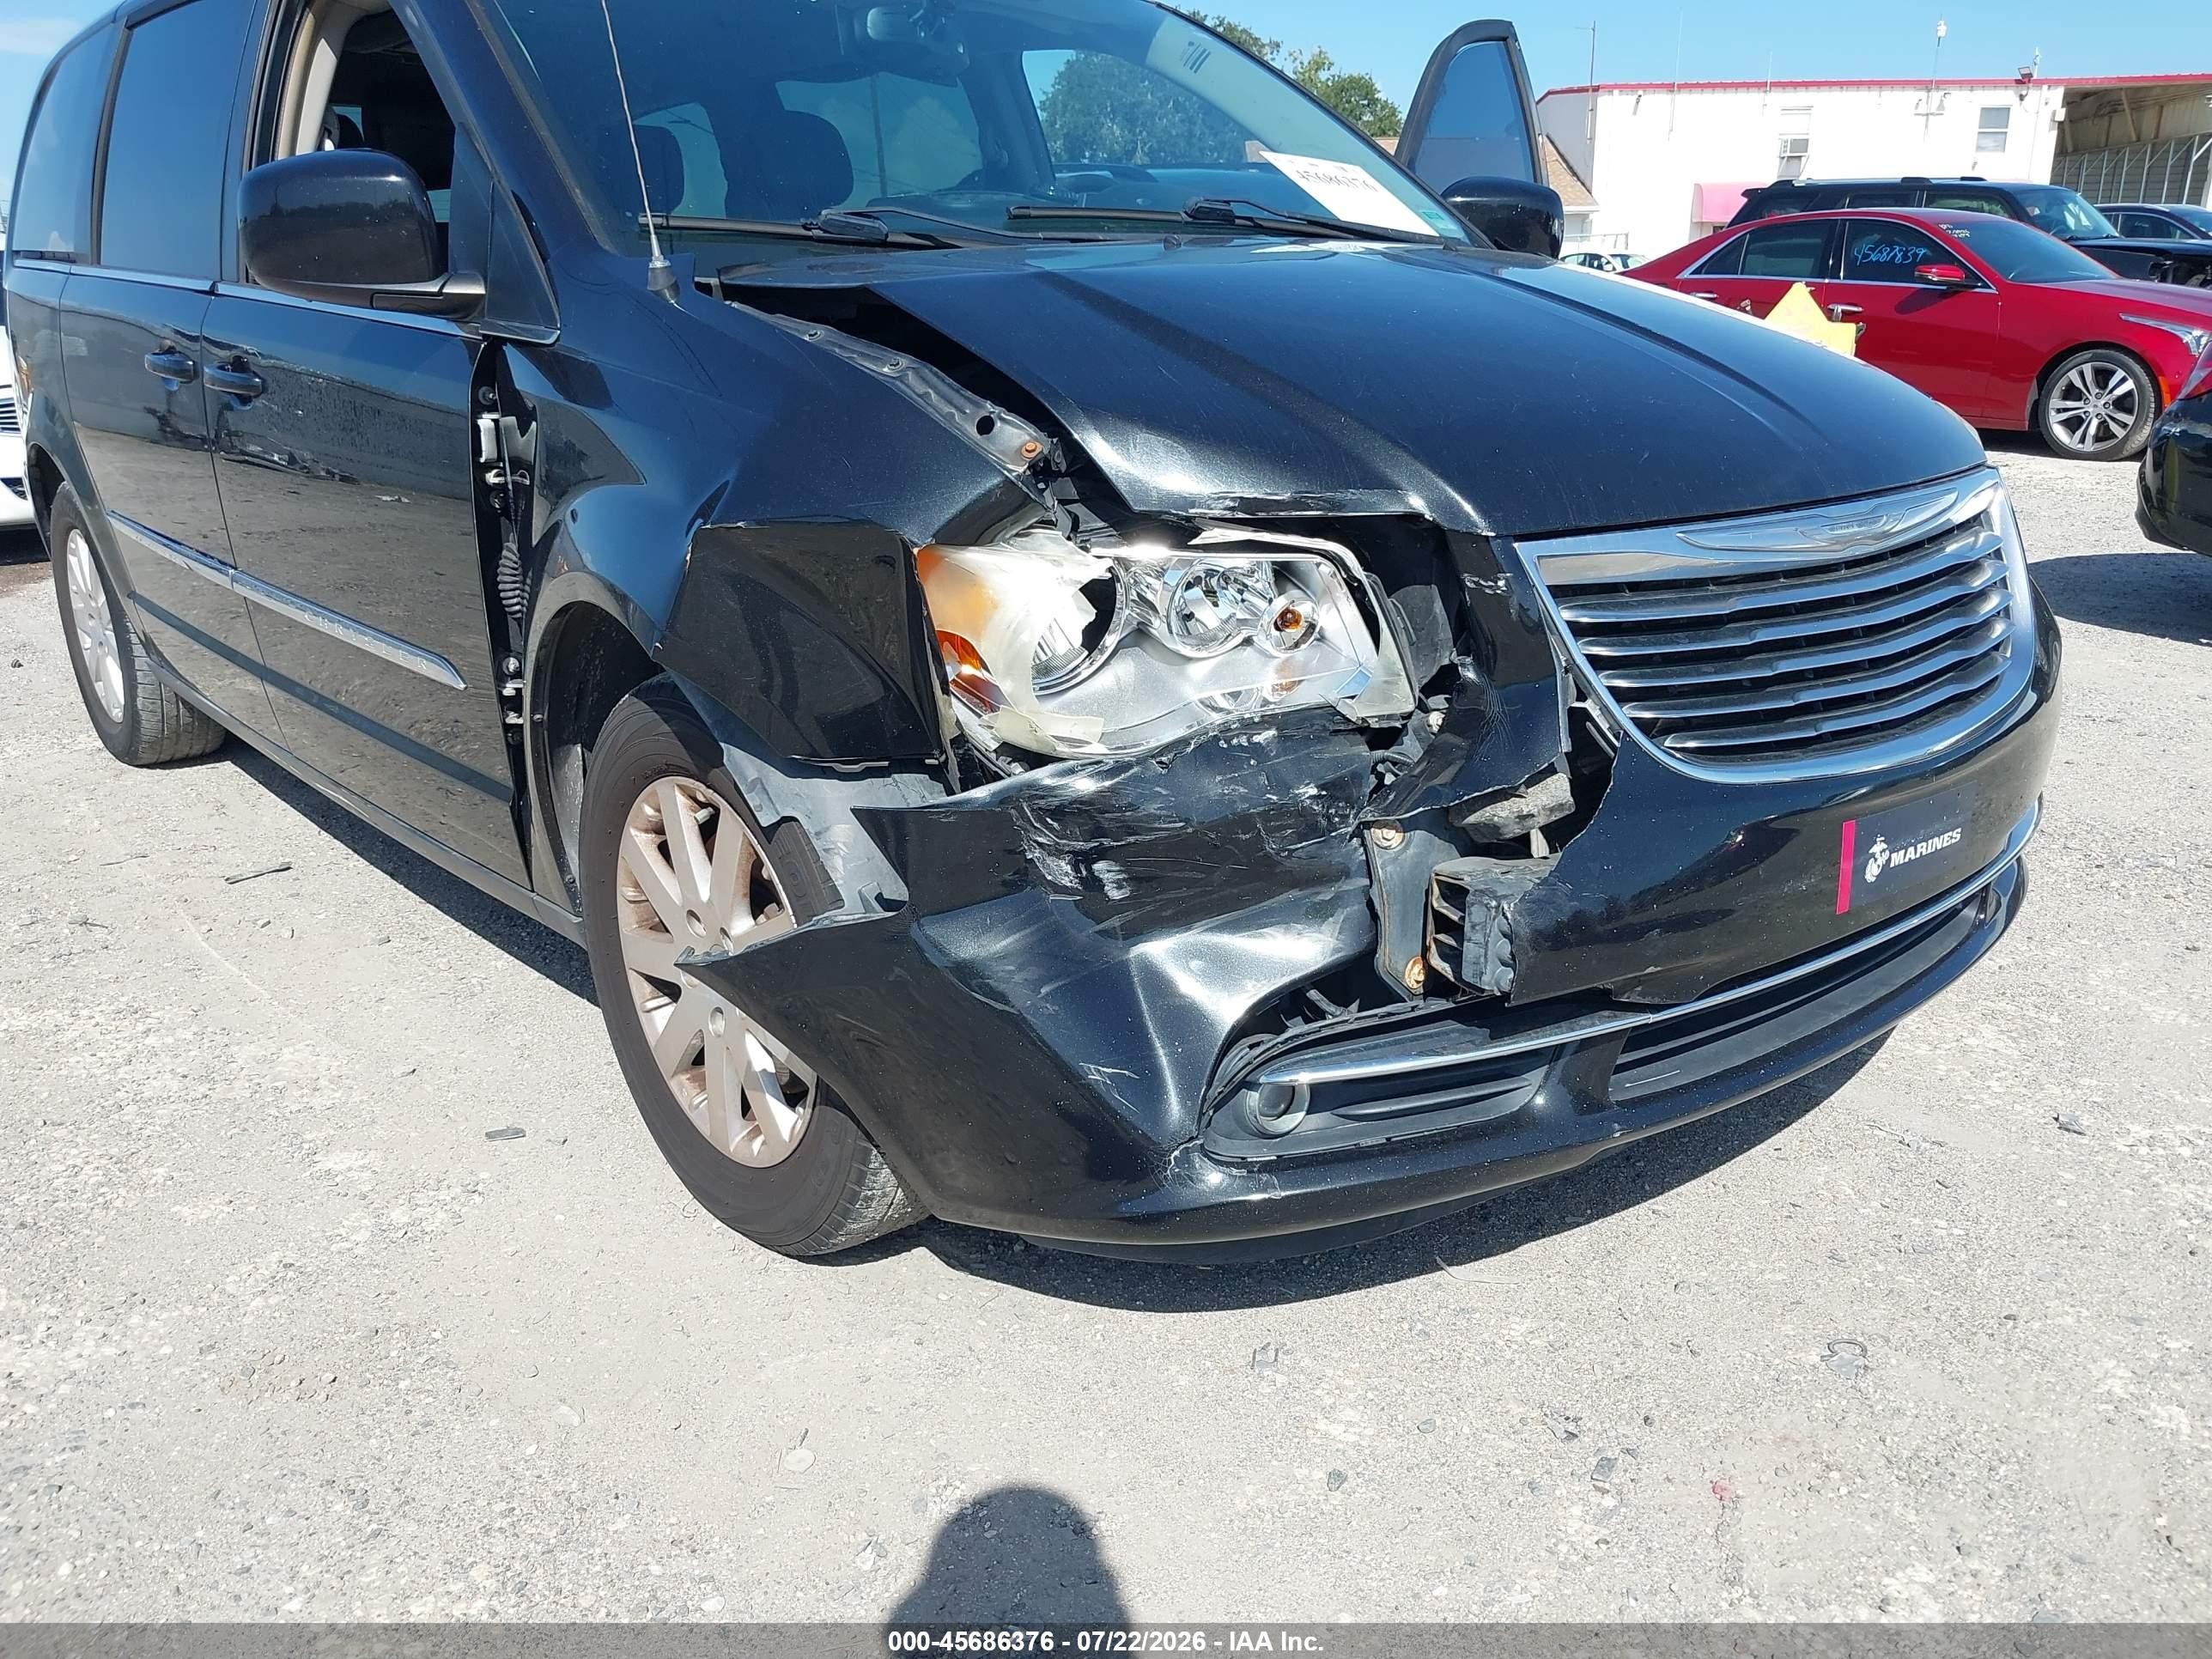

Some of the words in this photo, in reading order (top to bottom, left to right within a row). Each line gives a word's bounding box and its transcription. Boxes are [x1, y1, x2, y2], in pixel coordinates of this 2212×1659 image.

[1854, 243, 1927, 265] 45687839
[303, 611, 428, 670] CHRYSLER
[1889, 827, 1962, 868] MARINES
